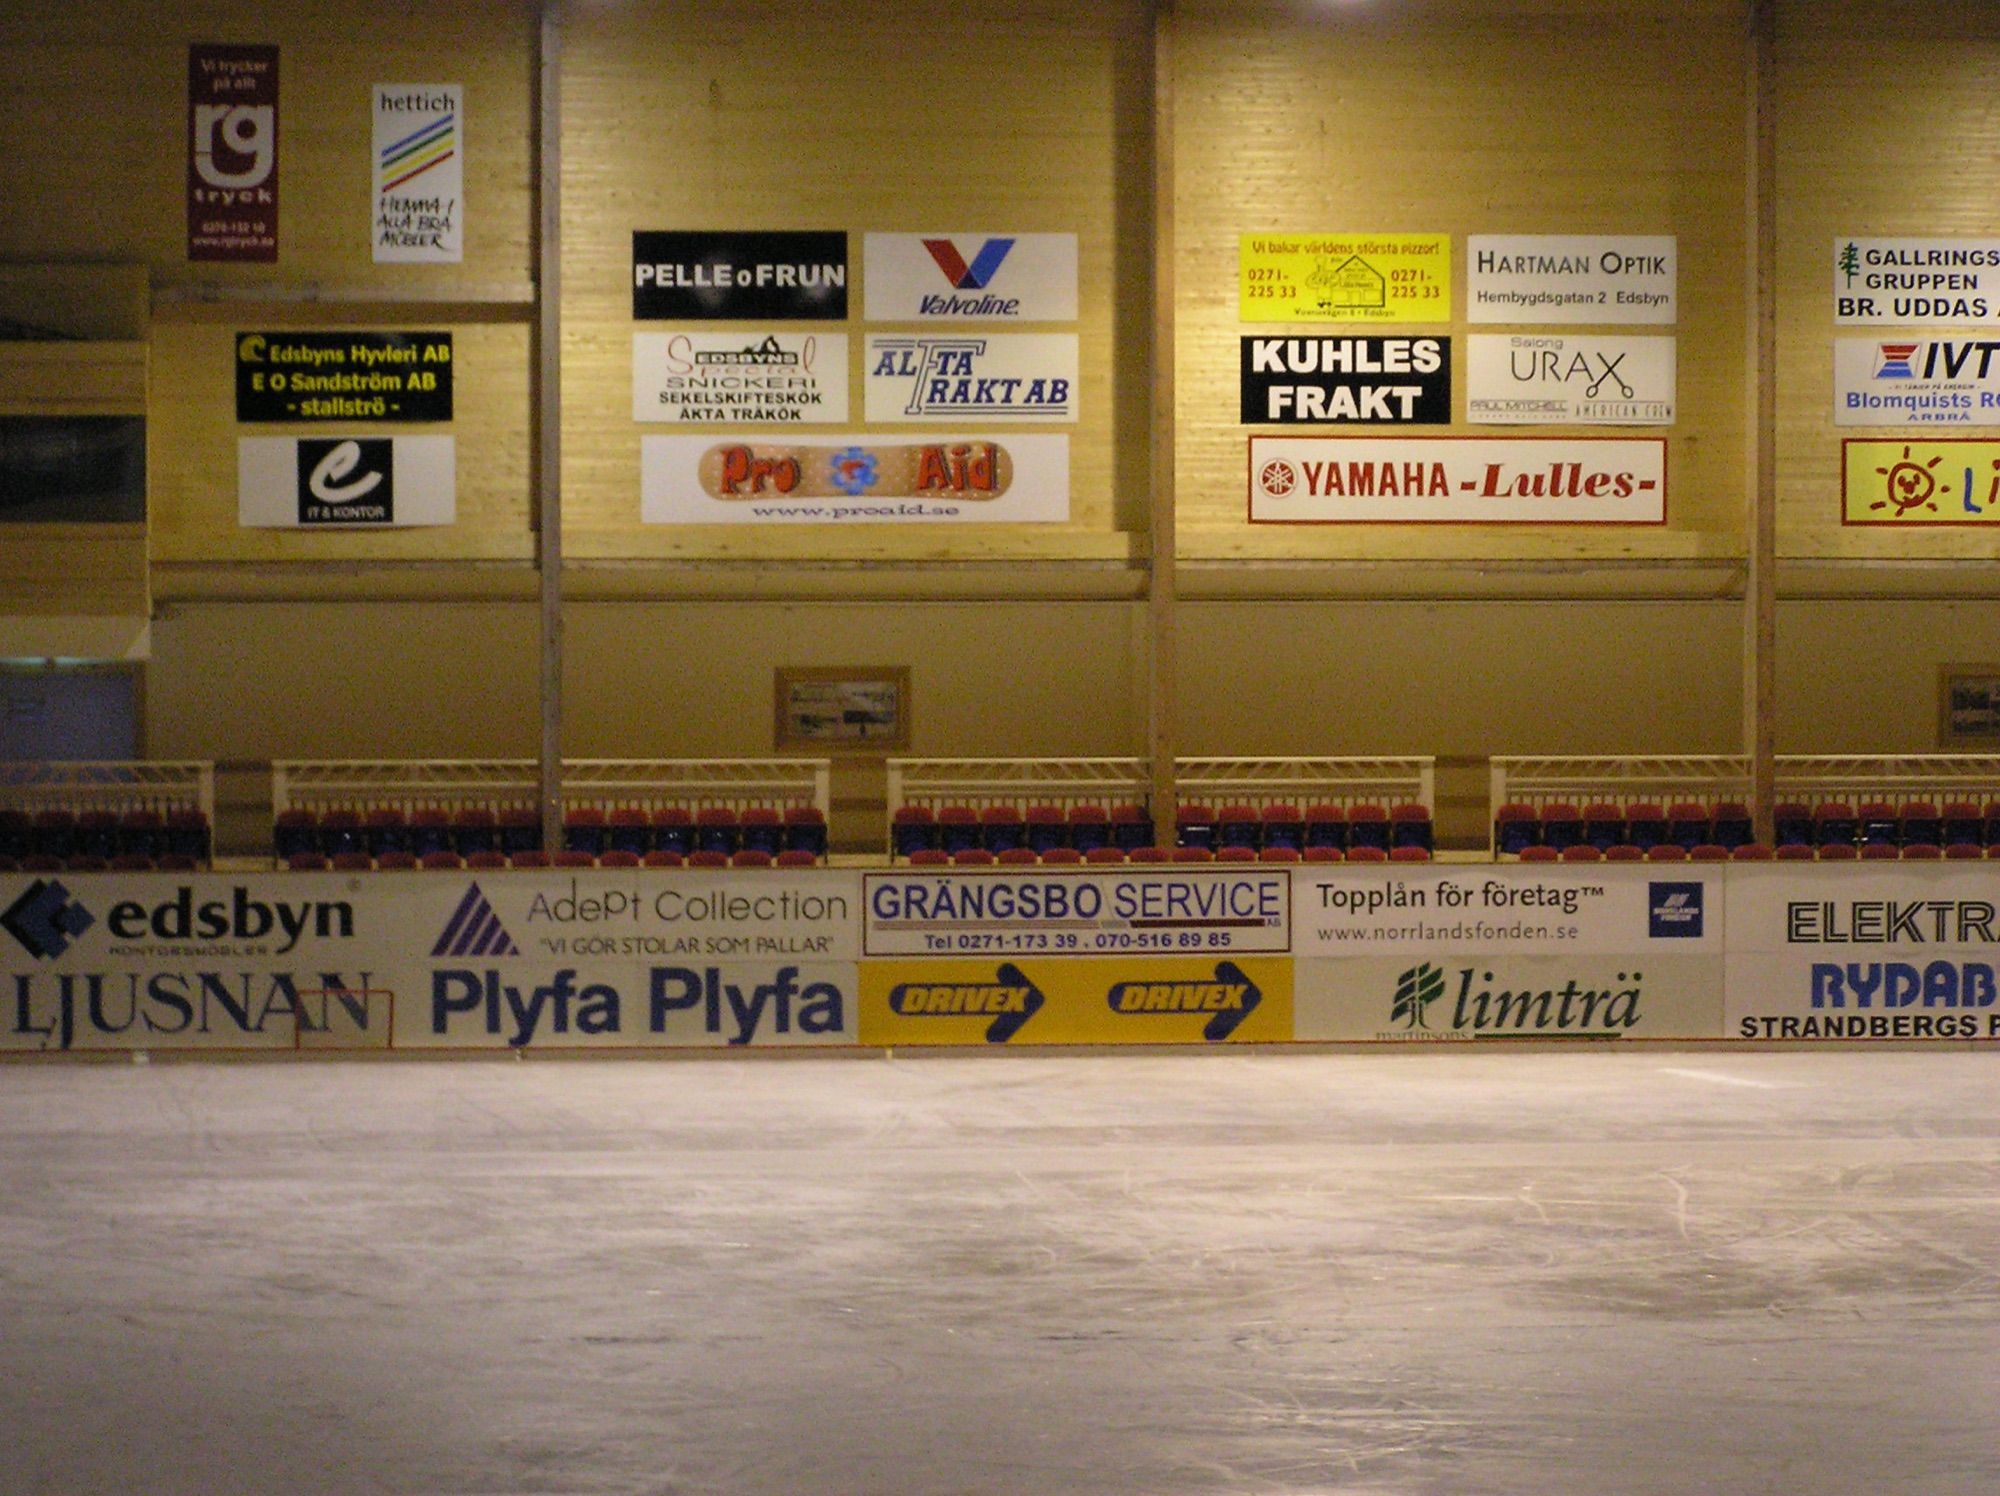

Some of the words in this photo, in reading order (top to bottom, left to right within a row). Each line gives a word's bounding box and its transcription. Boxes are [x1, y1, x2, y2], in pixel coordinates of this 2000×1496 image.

[381, 92, 455, 112] hettich
[194, 188, 272, 206] tryck
[1268, 241, 1300, 254] bakar
[1304, 240, 1353, 254] världens
[1478, 251, 1590, 274] HARTMAN
[1600, 251, 1666, 275] OPTIK
[1866, 250, 2000, 266] GALLRINGS
[635, 264, 732, 287] PELLE
[756, 264, 845, 287] FRUN
[1248, 269, 1289, 281] 0271-
[1391, 269, 1432, 281] 0271-
[1866, 273, 1978, 290] GRUPPEN
[1248, 286, 1274, 298] 225
[1279, 286, 1297, 298] 33
[1391, 287, 1417, 298] 225
[1422, 287, 1440, 298] 33
[1477, 291, 1594, 306] Hembygdsgatan
[1598, 291, 1606, 304] 2
[1616, 291, 1669, 307] Edsbyn
[1838, 298, 1882, 317] BR.
[1894, 298, 1988, 317] UDDAS
[1511, 337, 1564, 350] Salong
[270, 345, 345, 367] Edsbyns
[351, 345, 417, 367] Hyvleri
[423, 345, 450, 363] AB
[698, 353, 795, 364] EDSBYNS
[1252, 340, 1441, 373] KUHLES
[1923, 342, 2000, 379] IVT
[252, 372, 264, 391] E
[269, 372, 286, 391] O
[291, 372, 401, 391] Sandström
[407, 372, 437, 391] AB
[666, 377, 816, 389] SNICKERI
[1511, 351, 1634, 399] URAX
[659, 391, 822, 404] SEKELSKIFTESKÖK
[1024, 379, 1069, 404] AB
[1847, 392, 1972, 411] Blomquists
[301, 397, 385, 416] stallströ
[1268, 386, 1423, 419] FRAKT
[680, 407, 725, 420] ÄKTA
[732, 406, 802, 420] TRÄKÖK
[719, 443, 801, 494] Pro
[918, 440, 1000, 492] Aid
[1302, 461, 1449, 497] YAMAHA
[307, 506, 319, 519] IT
[333, 505, 384, 519] KONTOR
[753, 504, 960, 519] www.proaid.se
[527, 877, 640, 922] Adept
[655, 891, 847, 921] Collection
[872, 880, 1102, 920] GRÄNGSBO
[1114, 882, 1281, 919] SERVICE
[1317, 881, 1425, 916] Topplån
[1435, 881, 1474, 908] för
[108, 886, 354, 954] edsbyn
[1787, 901, 2000, 943] ELEKTR
[925, 934, 952, 949] Tel
[958, 934, 1047, 949] 0271-173
[1055, 934, 1078, 948] 39
[1095, 933, 1172, 948] 070-516
[1179, 933, 1202, 947] 89
[1208, 933, 1232, 947] 85
[1317, 921, 1579, 941] www.norrlandsfonden.se
[623, 936, 699, 955] STOLAR
[706, 936, 749, 955] SOM
[1811, 960, 1997, 1008] RYDAB
[432, 968, 621, 1047] Plyfa
[649, 966, 844, 1045] Plyfa
[901, 985, 1030, 1014] DRIVEX
[1119, 983, 1249, 1012] DRIVEX
[1452, 968, 1643, 1030] limträ
[12, 972, 374, 1050] LJUSNAN
[1739, 1014, 1978, 1038] STRANDBERGS
